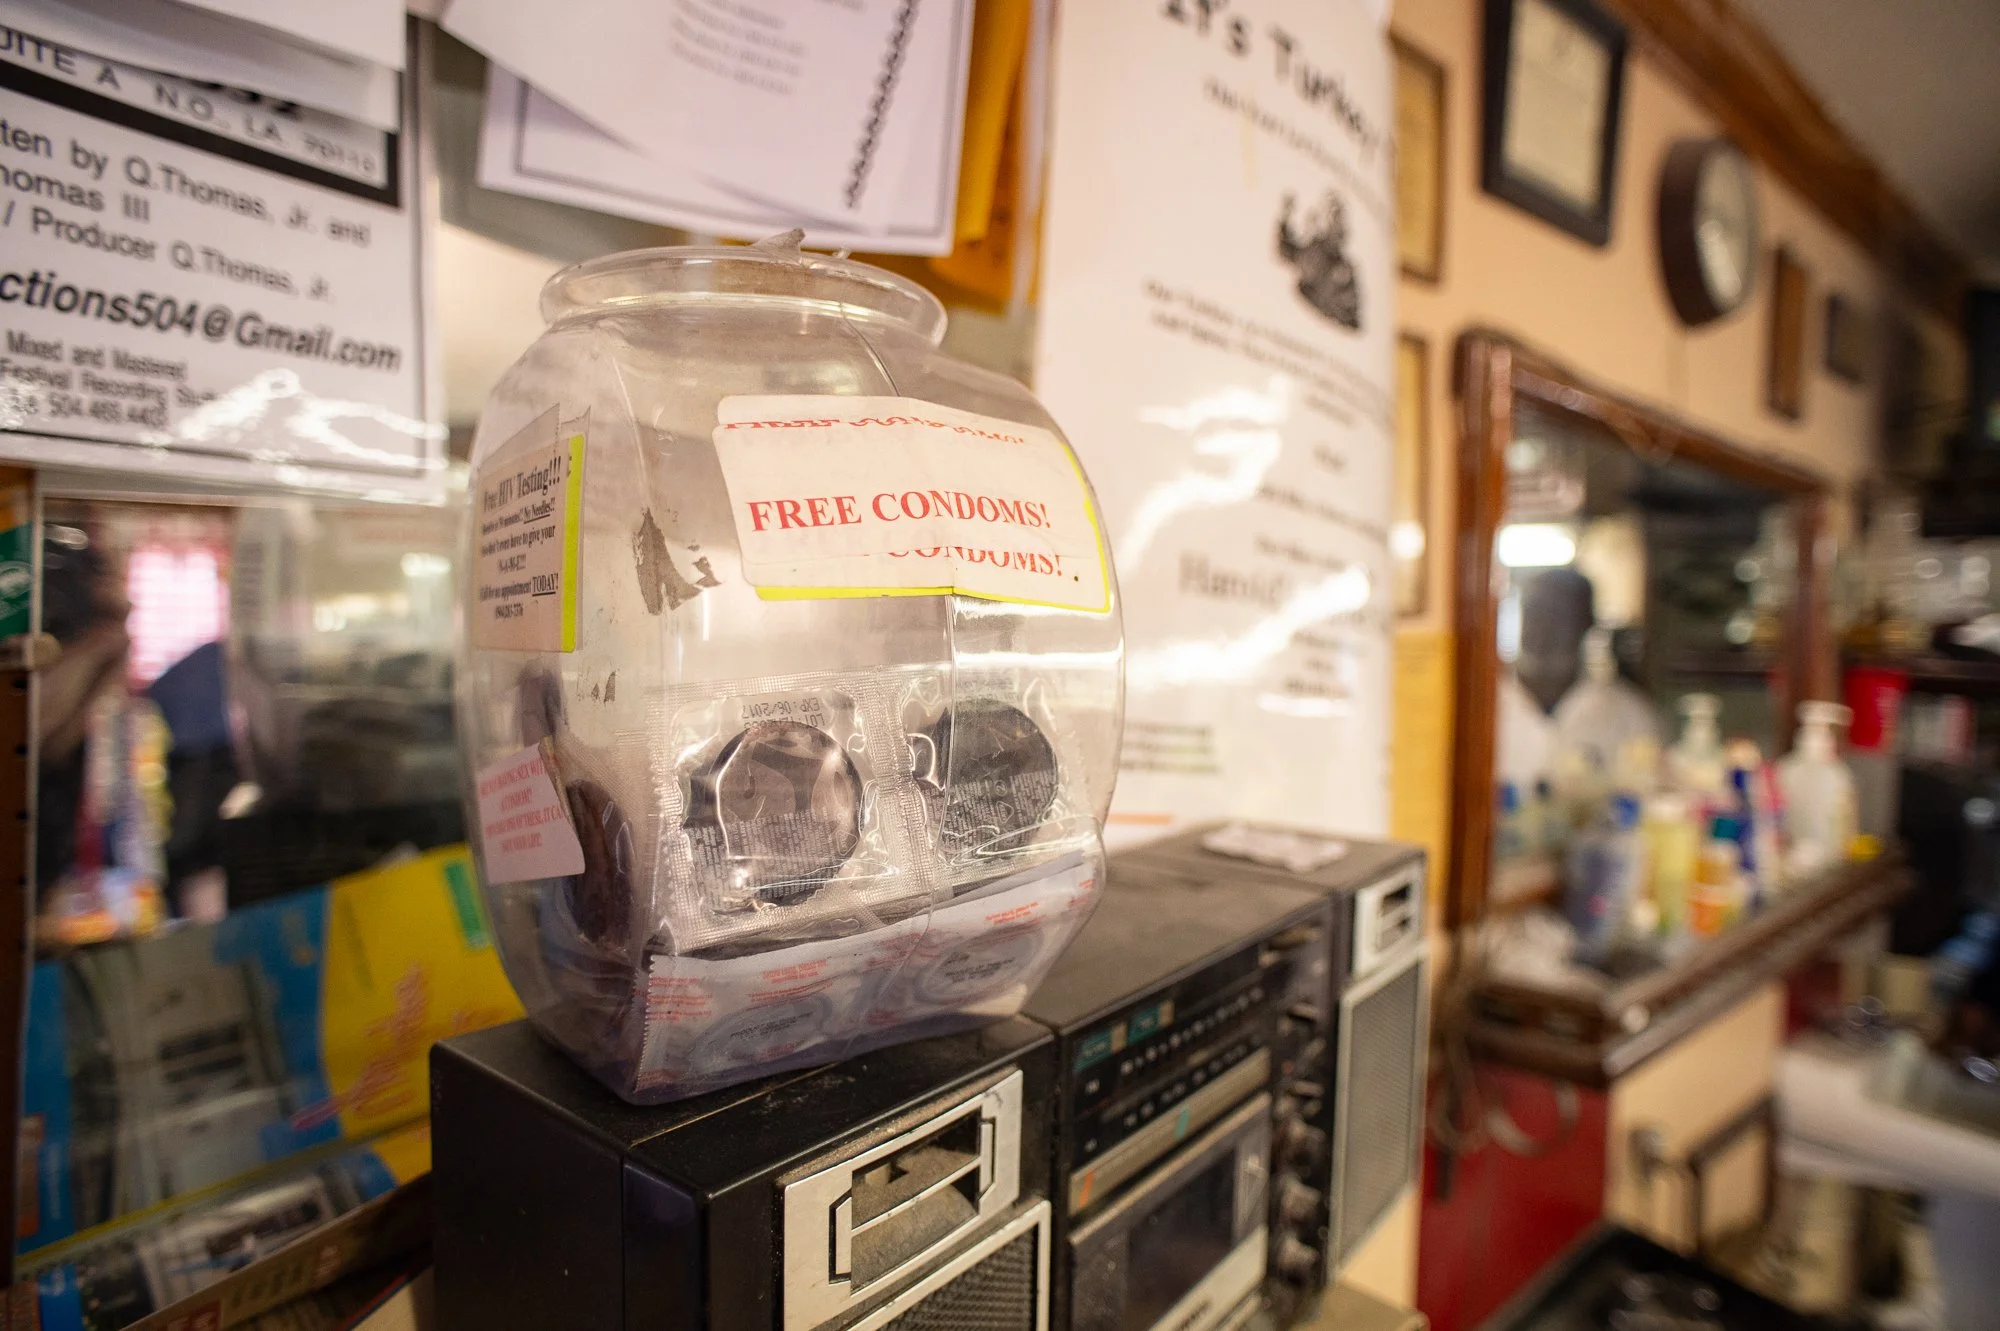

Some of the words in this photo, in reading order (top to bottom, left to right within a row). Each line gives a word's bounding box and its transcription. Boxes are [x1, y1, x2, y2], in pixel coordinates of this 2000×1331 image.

[97, 62, 122, 90] A
[243, 113, 285, 145] LA
[71, 135, 108, 180] by
[327, 215, 372, 248] and
[123, 191, 151, 224] III
[31, 206, 157, 260] Producer
[0, 269, 402, 373] ctions504@Gmail.com
[7, 327, 63, 361] Mixed
[72, 340, 105, 368] and
[498, 478, 515, 507] HIV
[516, 455, 562, 496] Testing!!!
[747, 495, 862, 533] FREE
[872, 490, 1051, 529] CONDOMS!
[510, 531, 522, 549] have
[529, 526, 541, 548] give
[541, 525, 556, 546] your
[501, 580, 531, 601] appointment
[532, 572, 559, 594] TODAY!
